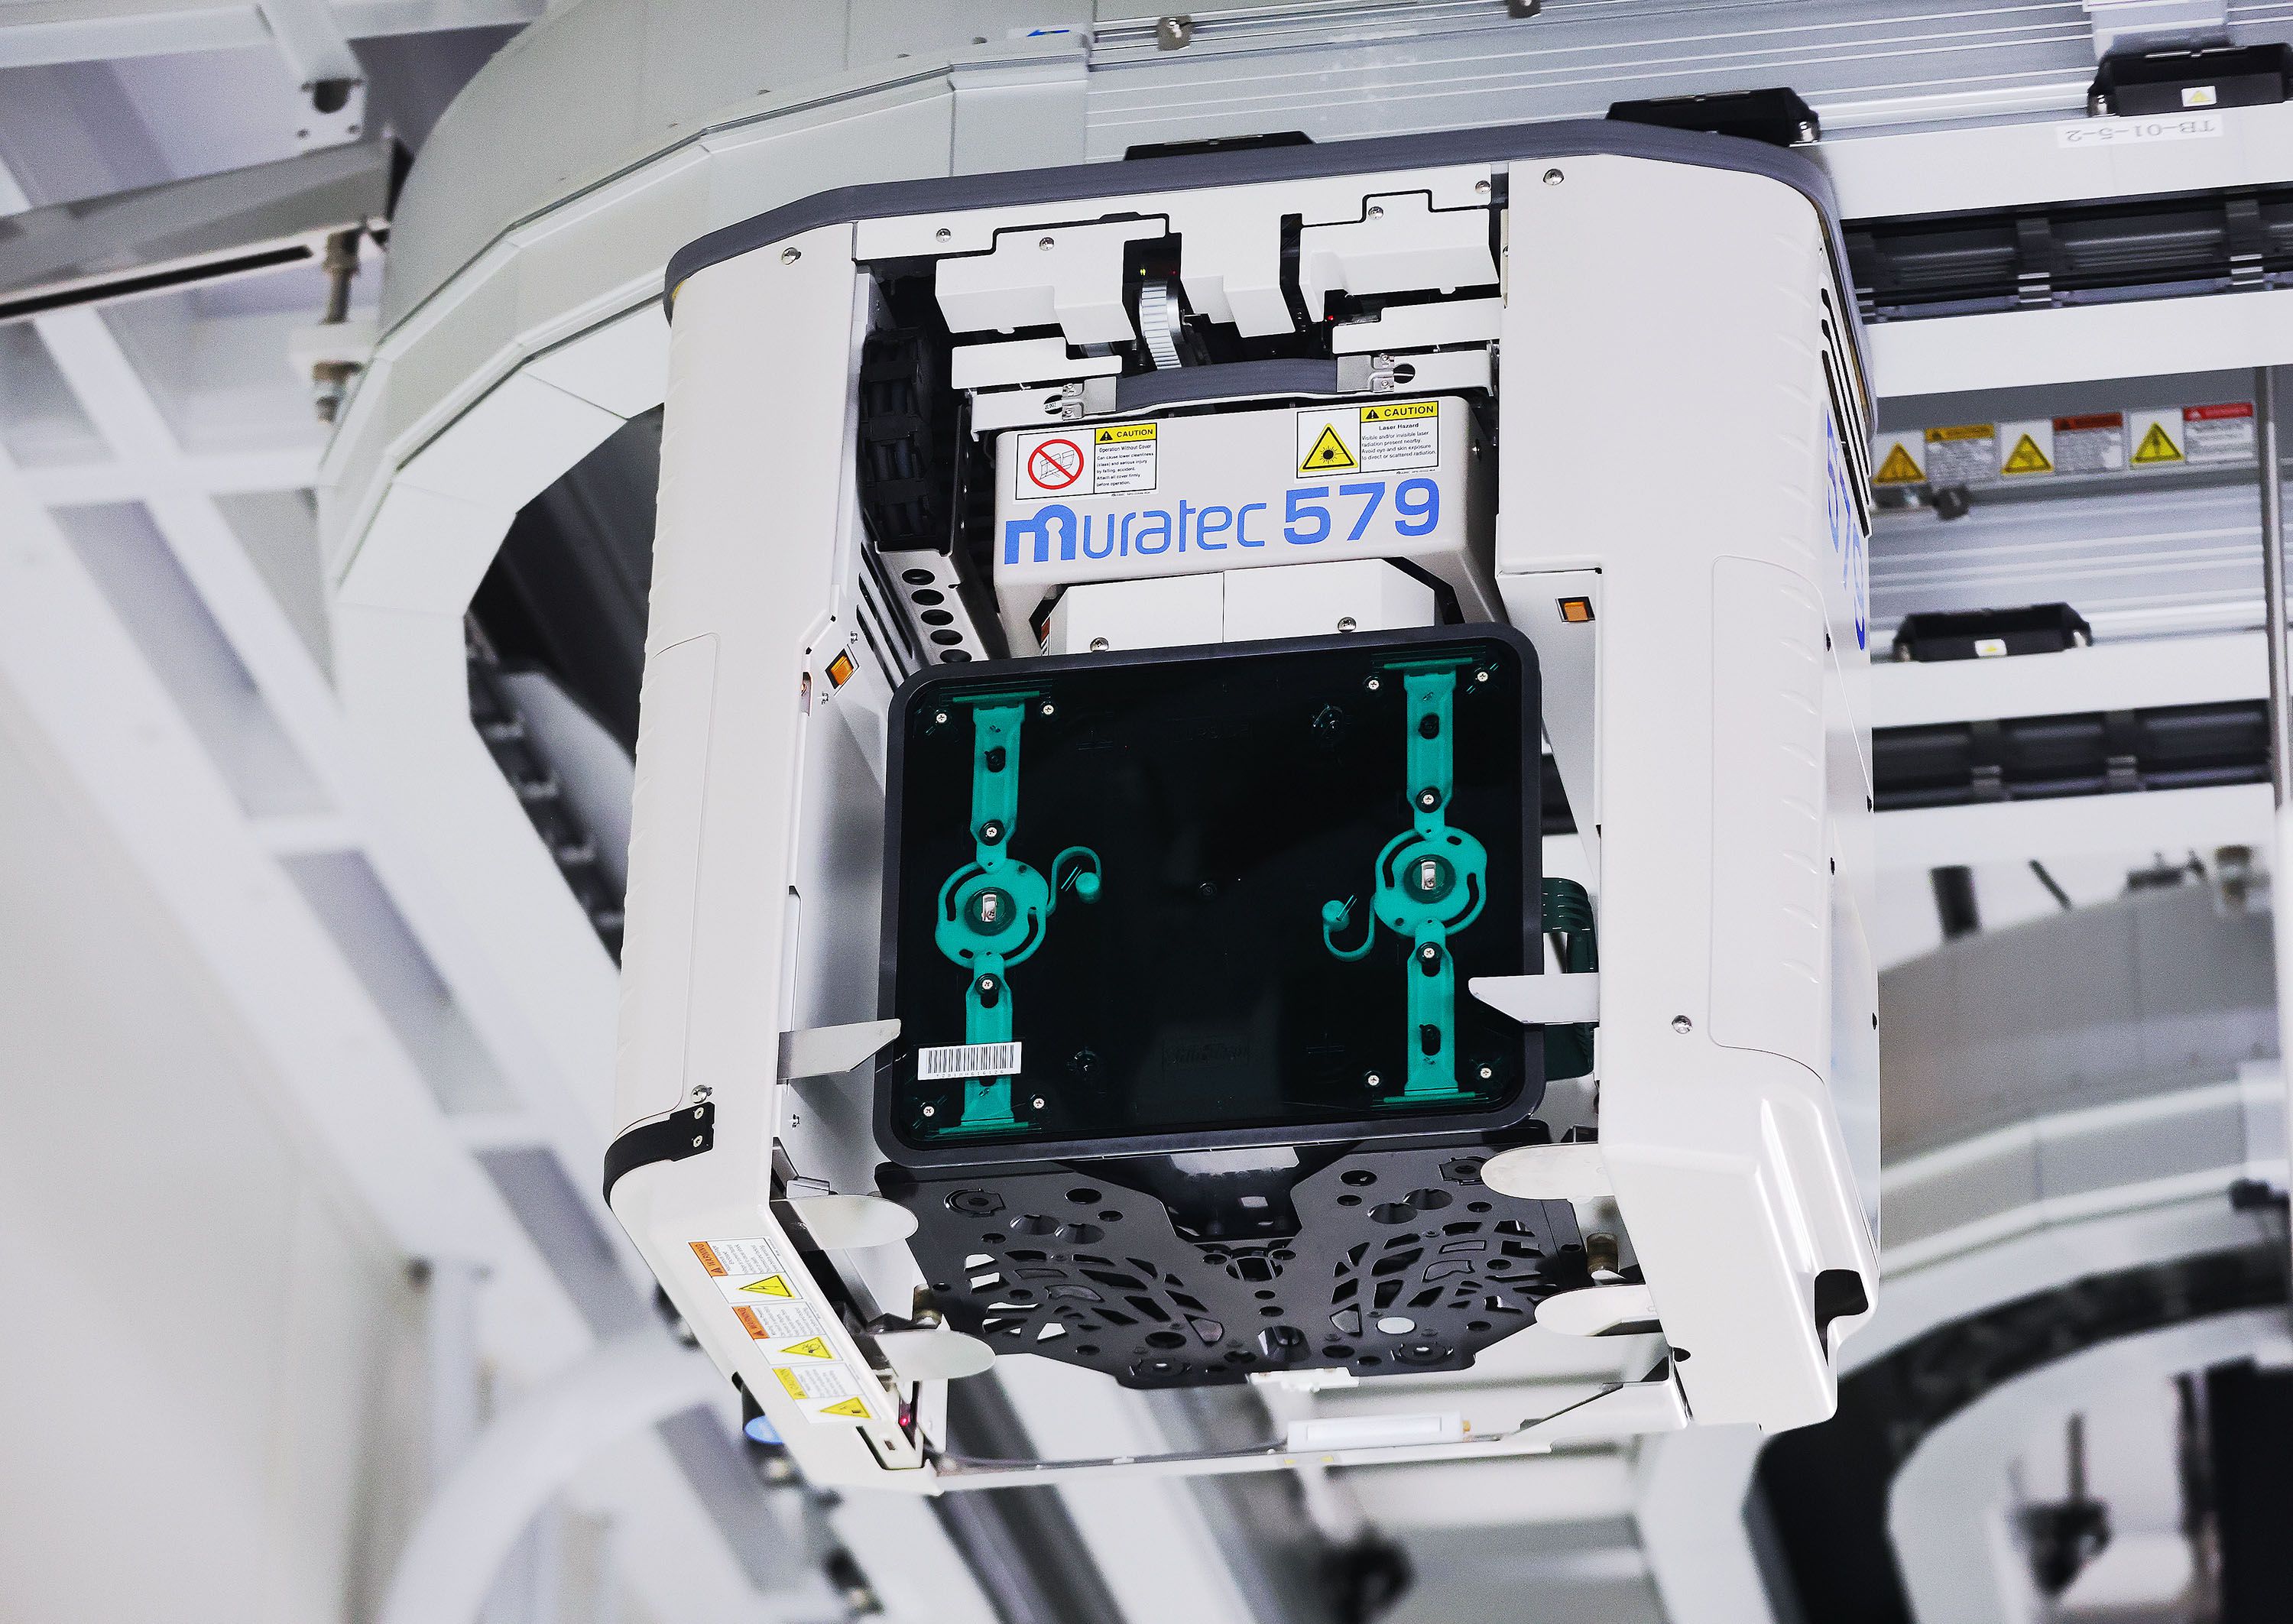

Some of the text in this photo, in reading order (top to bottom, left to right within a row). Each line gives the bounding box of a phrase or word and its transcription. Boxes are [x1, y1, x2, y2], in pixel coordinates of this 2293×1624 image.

[2066, 119, 2215, 142] TB-01-5-2
[1384, 405, 1434, 417] CAUTION
[1116, 429, 1153, 438] CAUTION
[1283, 478, 1441, 545] 579
[695, 1243, 715, 1267] WARNING
